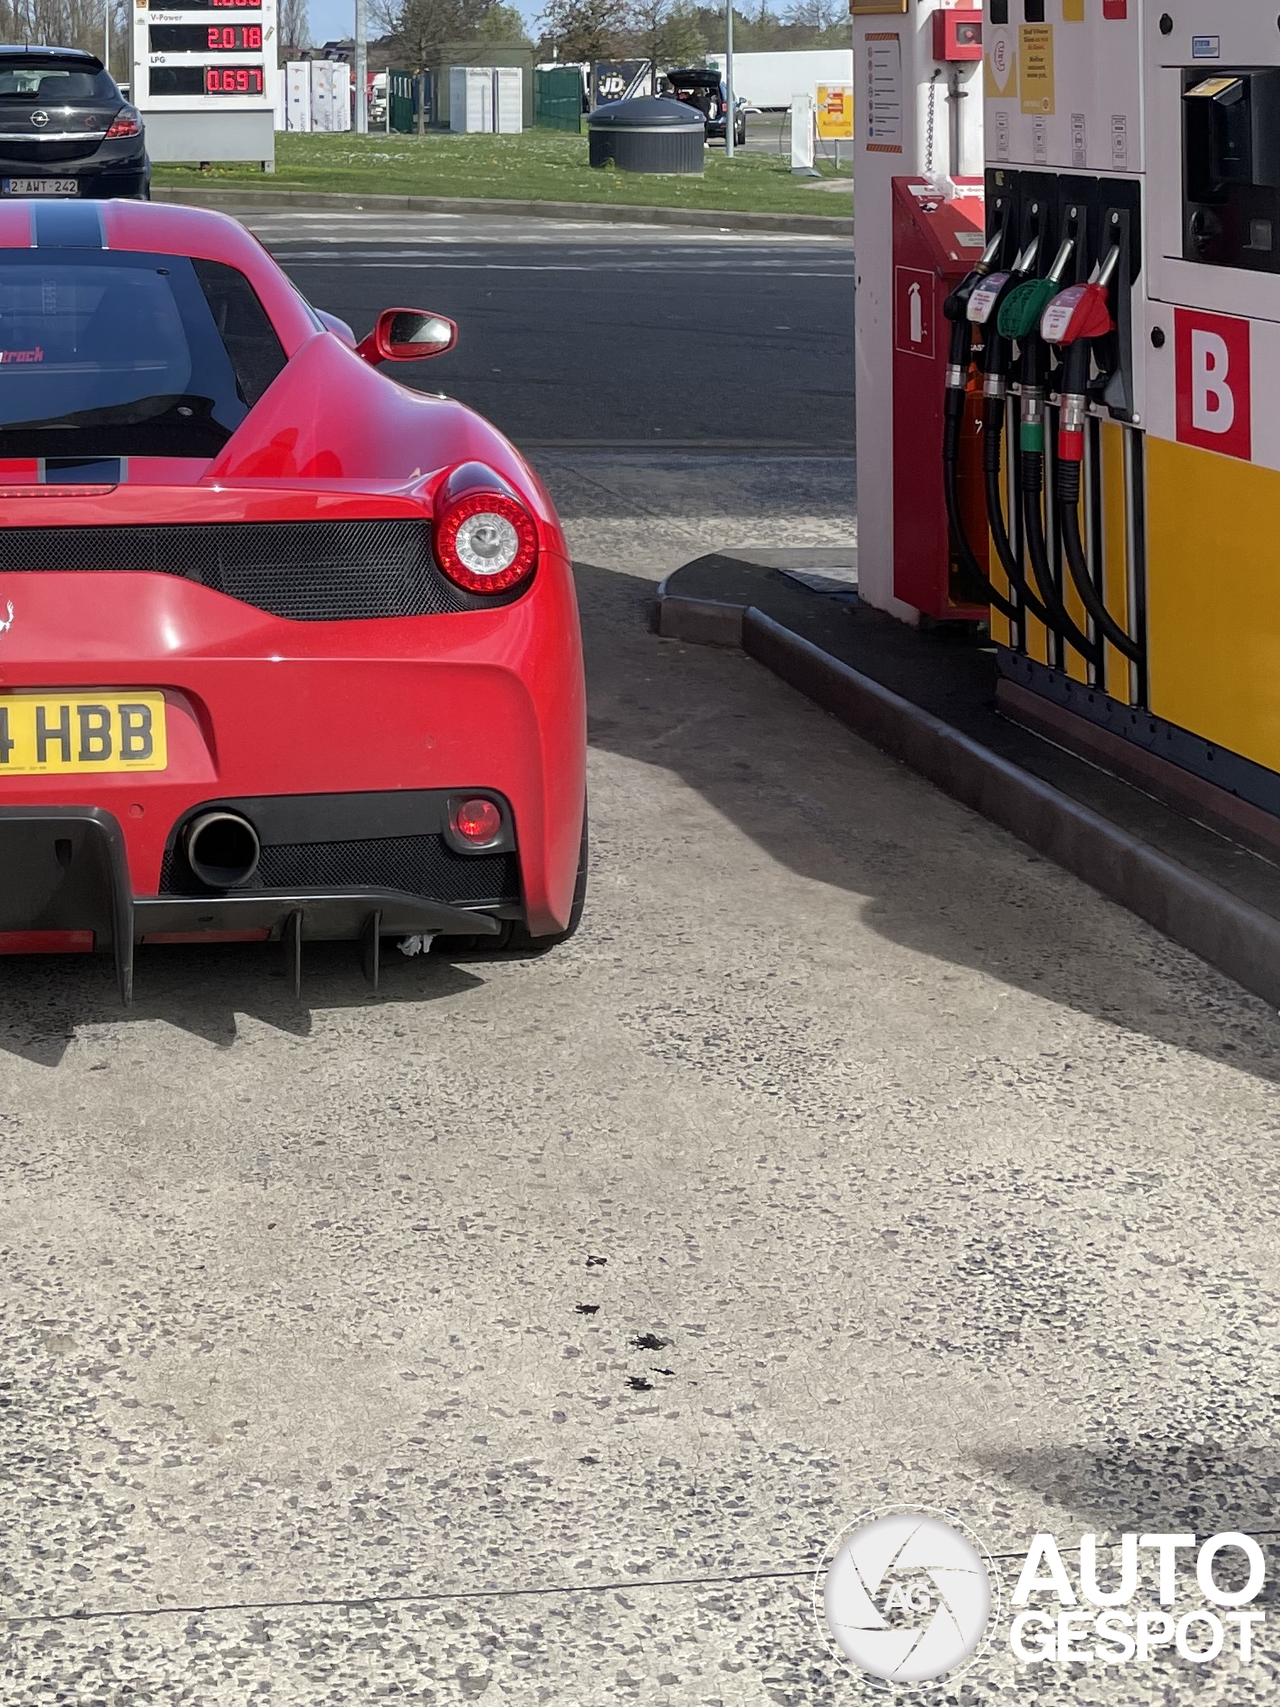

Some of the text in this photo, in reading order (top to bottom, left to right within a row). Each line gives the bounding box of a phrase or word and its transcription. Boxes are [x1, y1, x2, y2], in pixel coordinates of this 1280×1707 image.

[150, 14, 183, 22] V-Power
[150, 56, 166, 64] LPG
[206, 69, 262, 92] 0.697
[599, 77, 624, 93] JD
[1191, 328, 1235, 434] B
[35, 703, 154, 763] HBB
